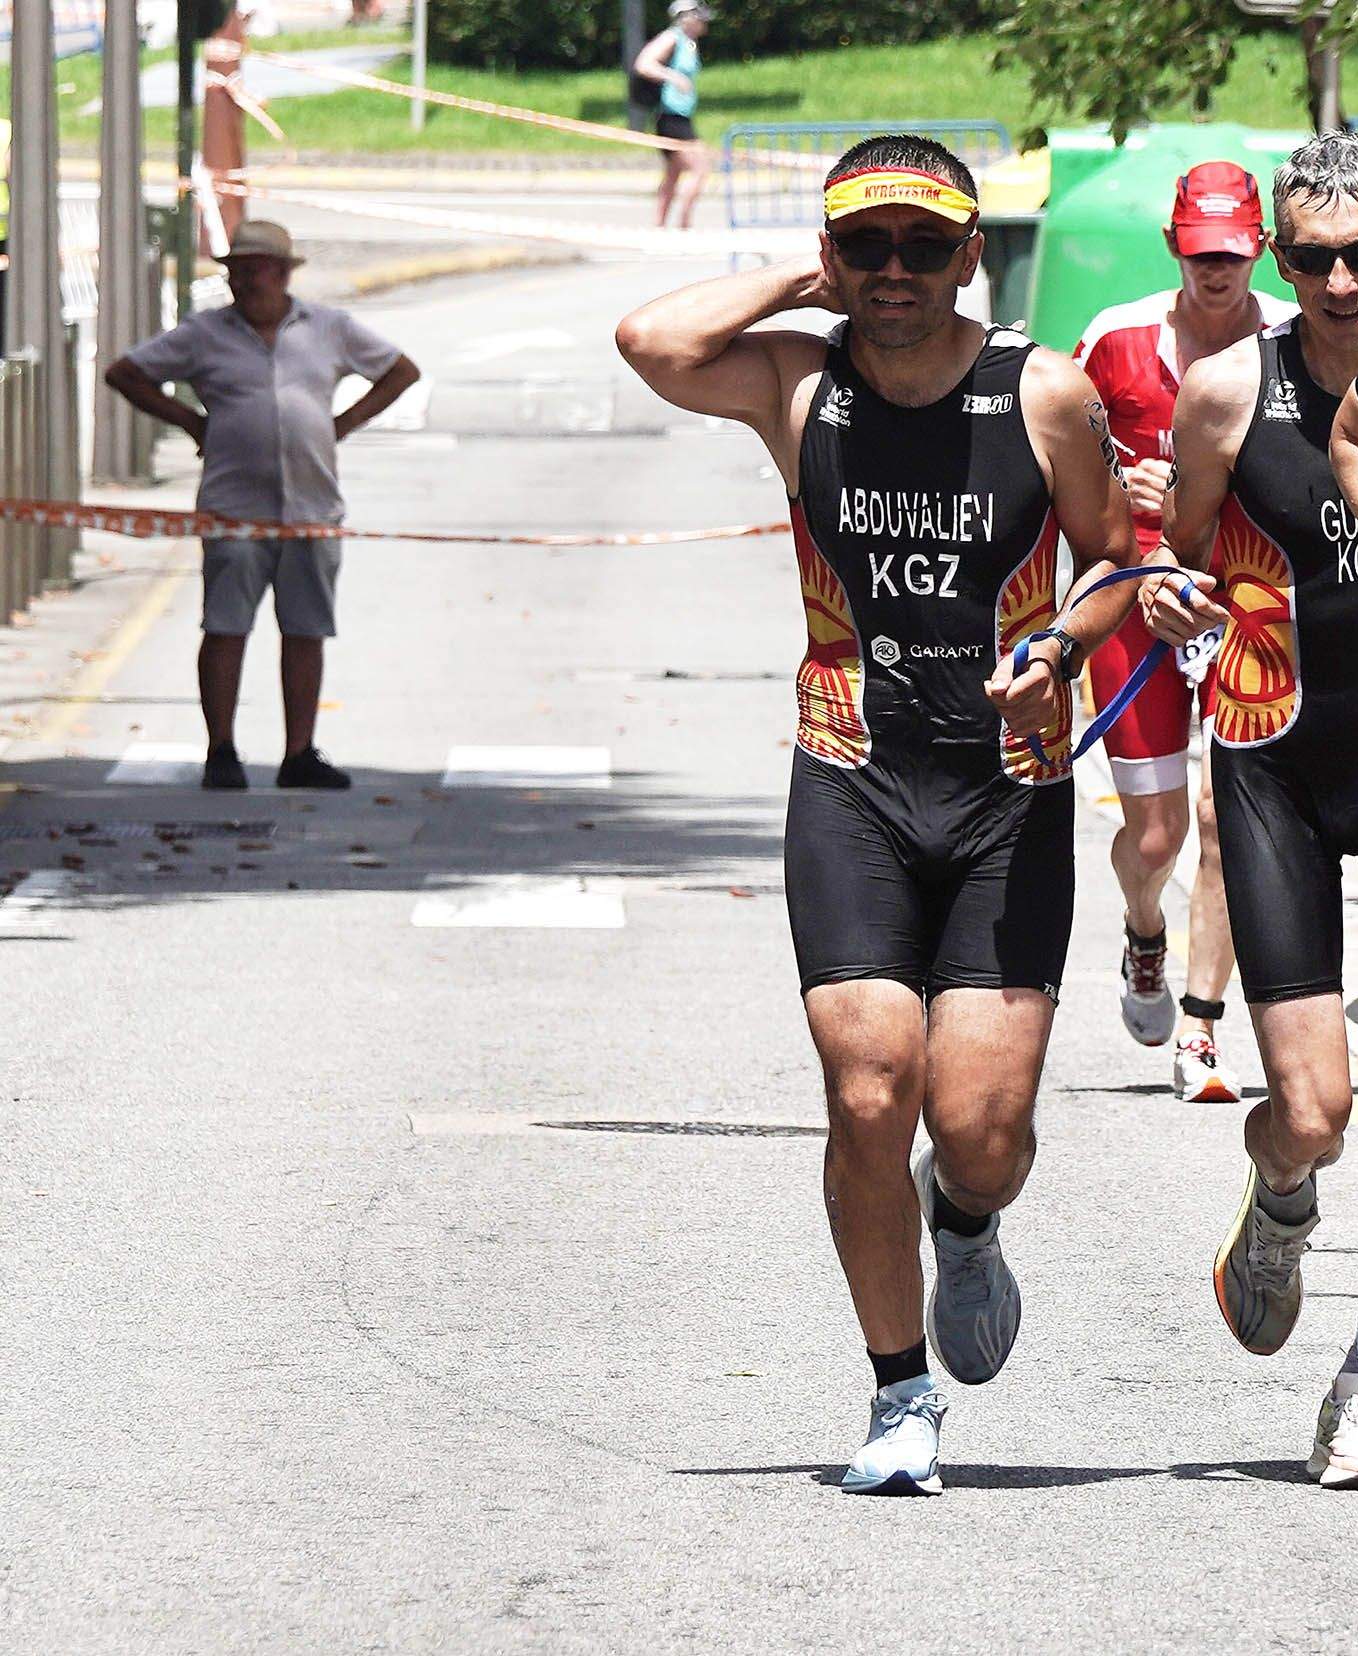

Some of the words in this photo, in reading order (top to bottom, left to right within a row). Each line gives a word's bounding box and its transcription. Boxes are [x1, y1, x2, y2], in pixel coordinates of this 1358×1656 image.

[838, 487, 994, 542] ABDUVALIEV
[868, 552, 960, 599] KGZ
[910, 644, 984, 659] GARANT
